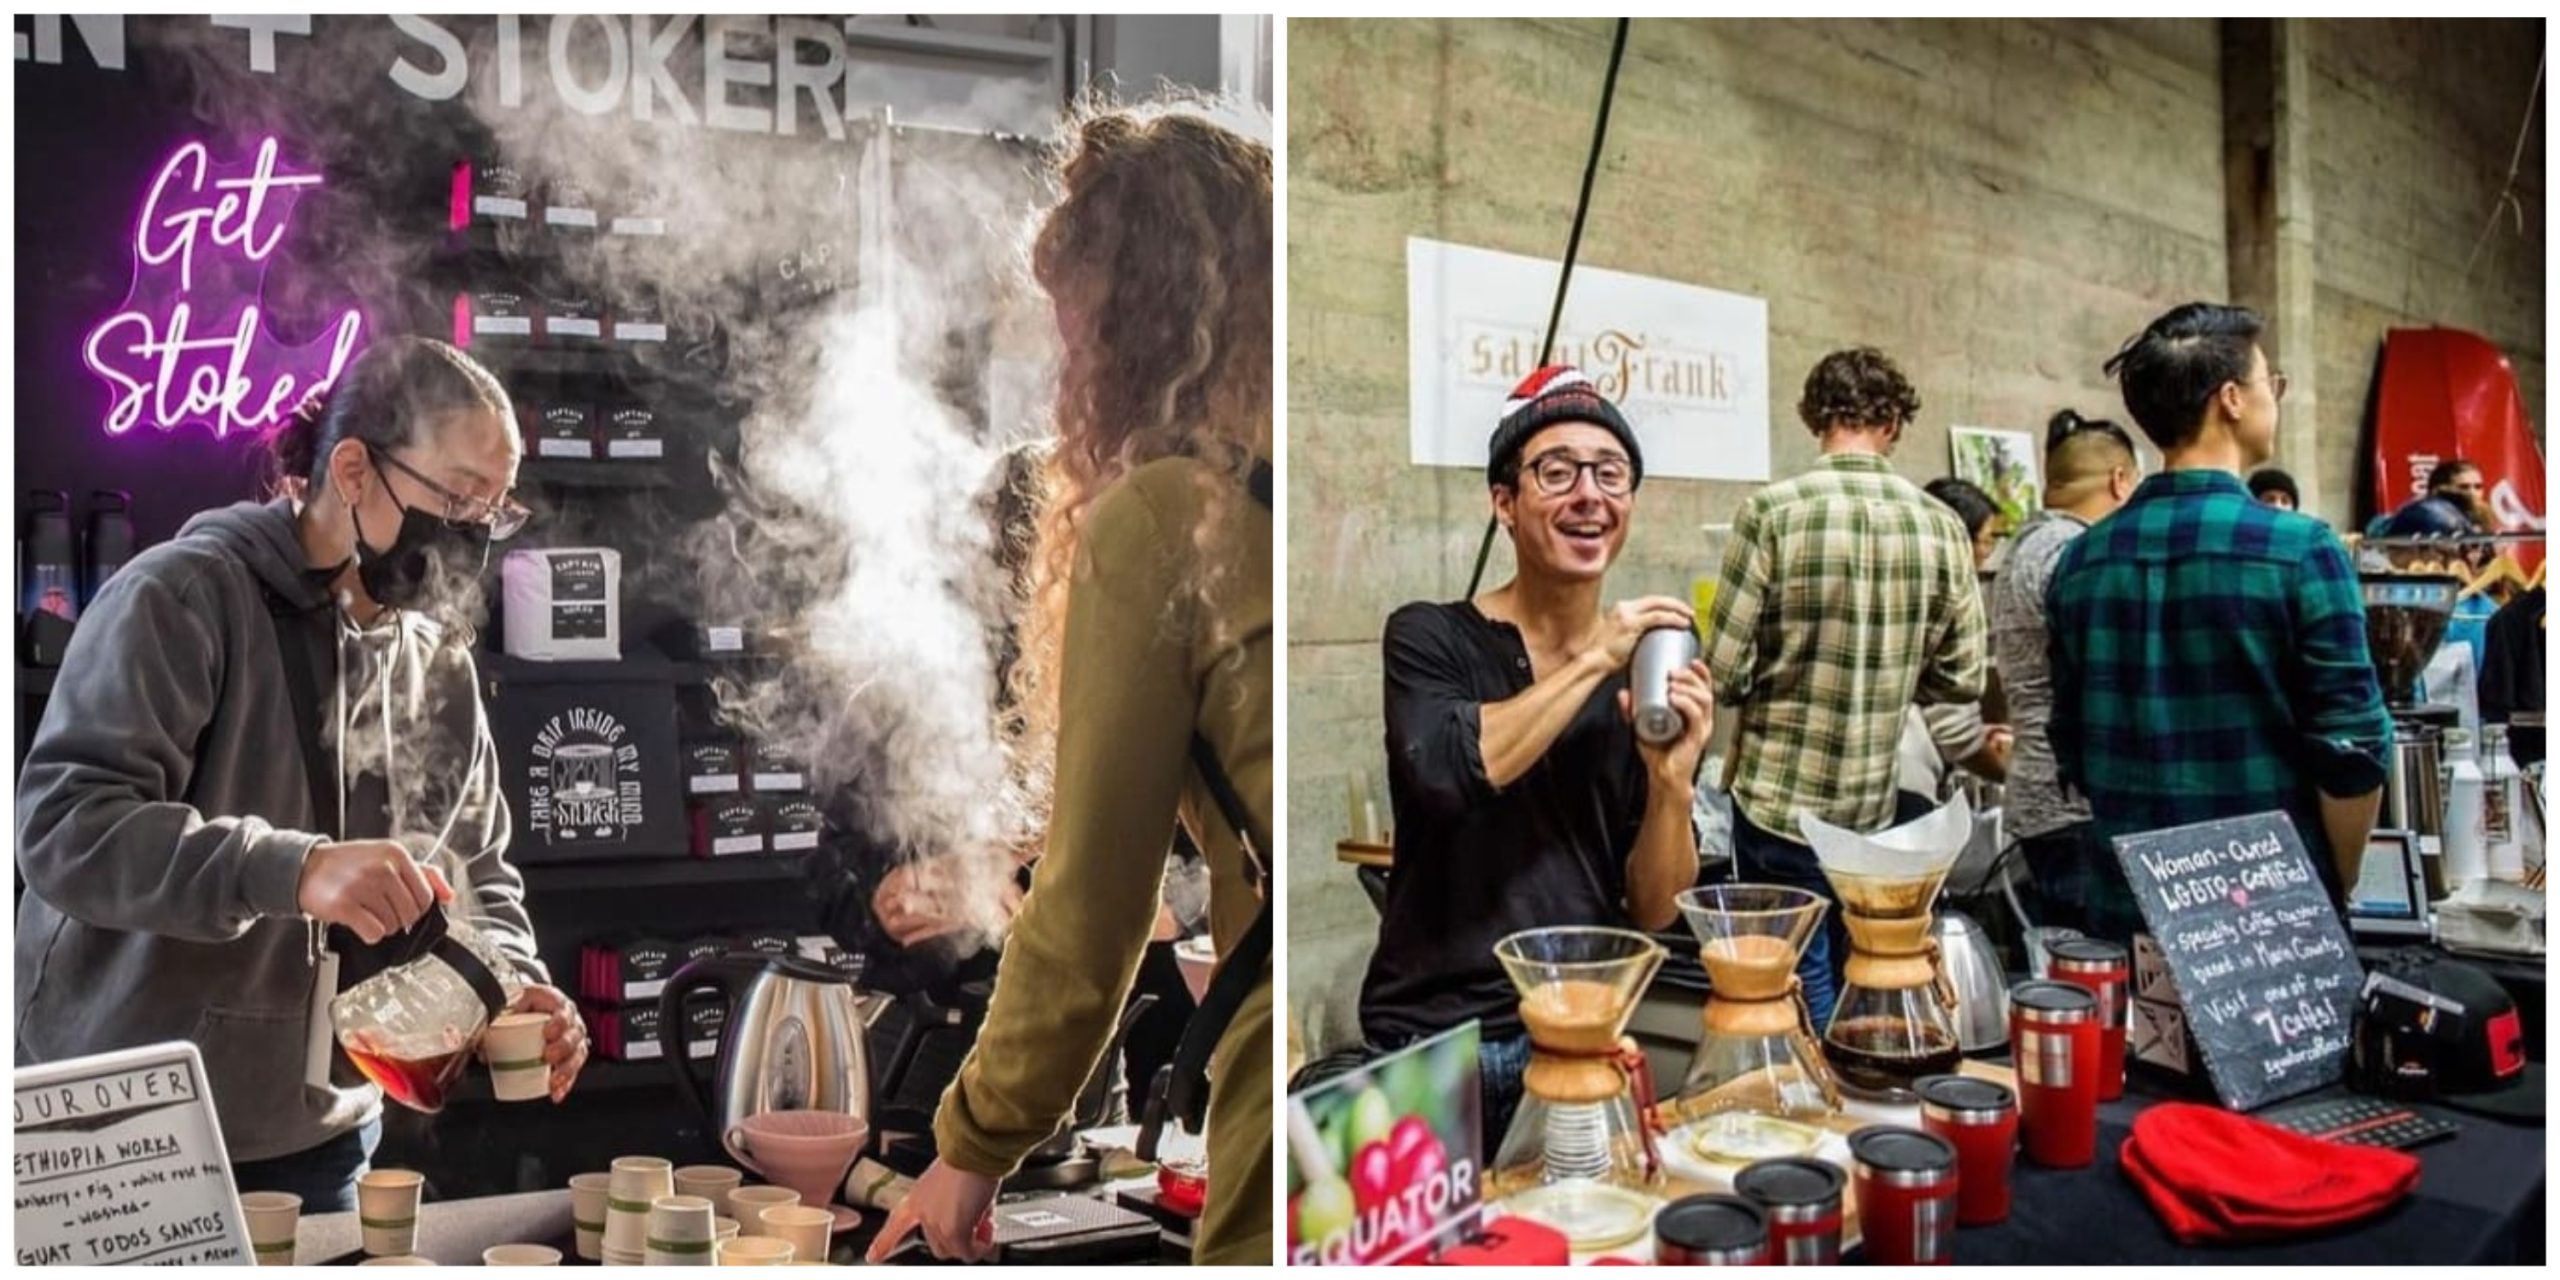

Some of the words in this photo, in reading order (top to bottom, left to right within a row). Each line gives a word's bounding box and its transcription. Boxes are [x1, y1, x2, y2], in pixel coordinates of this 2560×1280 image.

[388, 14, 846, 141] STOKER
[137, 136, 324, 291] Get
[86, 302, 361, 437] Stoked
[95, 1070, 188, 1109] OVER
[14, 1145, 106, 1176] ETHIOPIA
[117, 1133, 181, 1157] WORKA
[86, 1228, 152, 1258] TODOS
[159, 1212, 225, 1242] SANTOS
